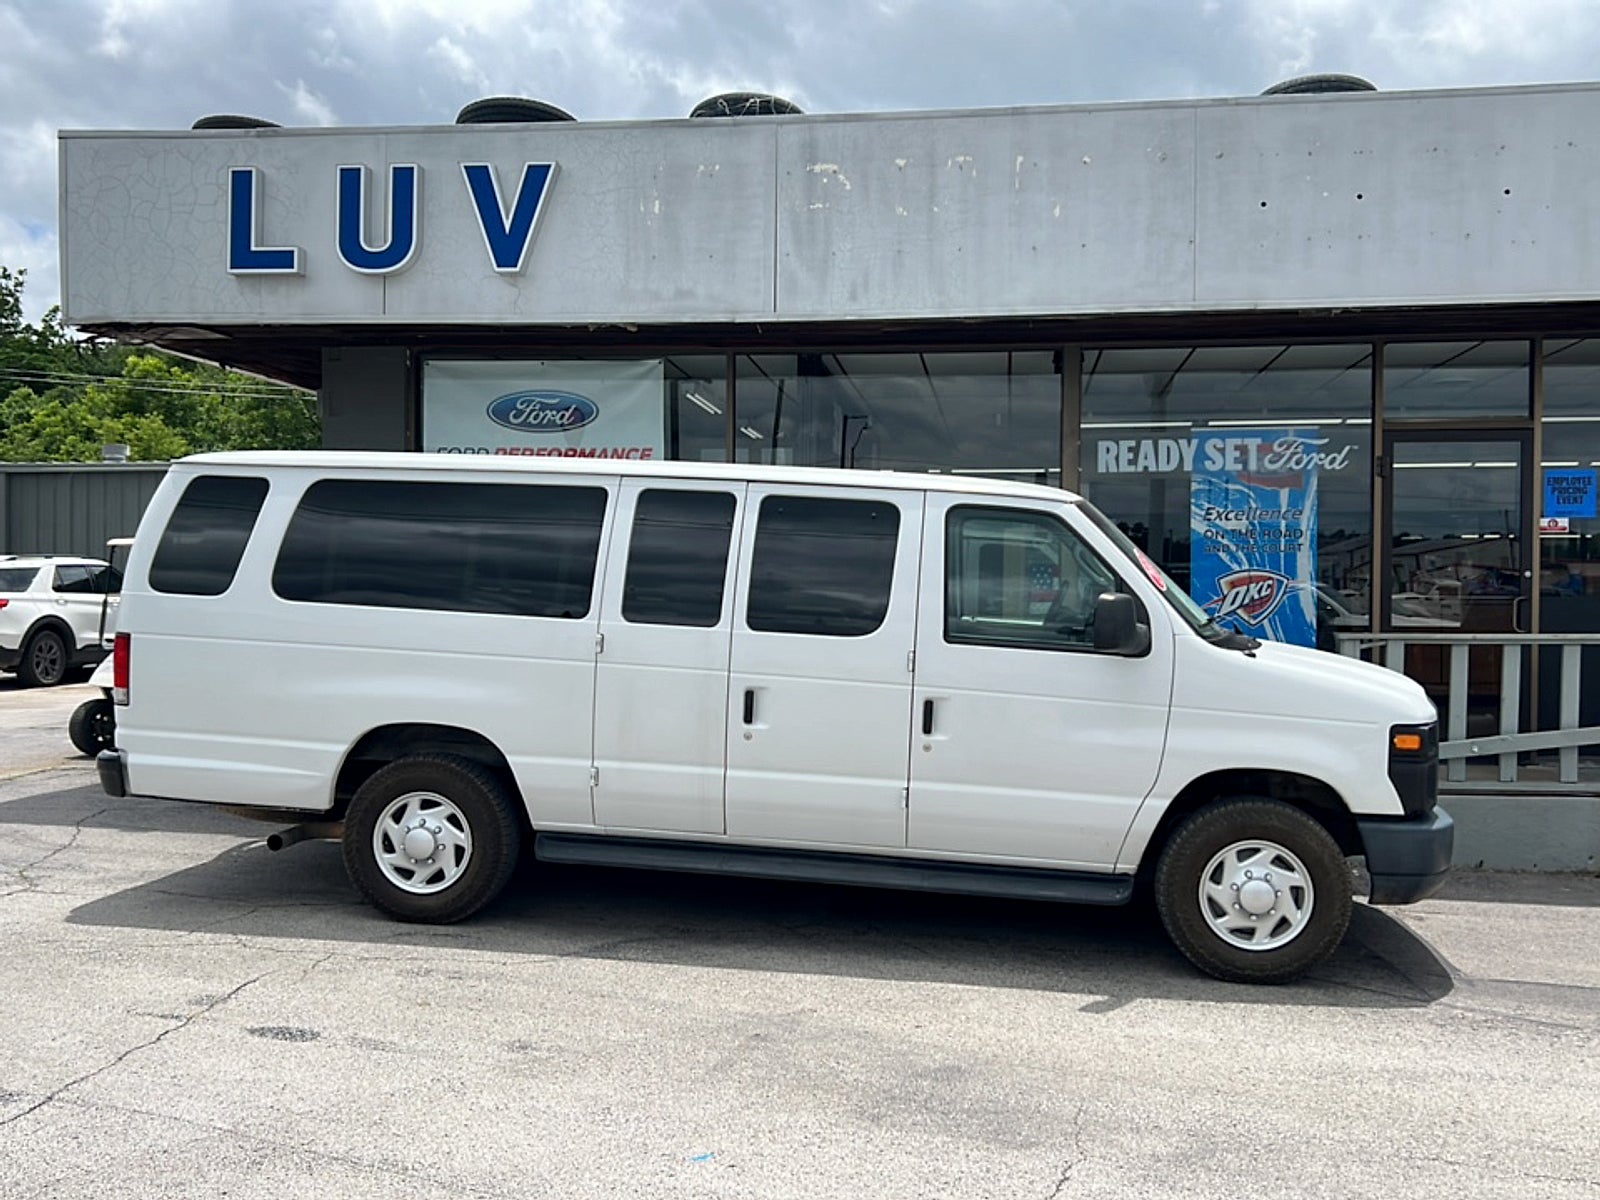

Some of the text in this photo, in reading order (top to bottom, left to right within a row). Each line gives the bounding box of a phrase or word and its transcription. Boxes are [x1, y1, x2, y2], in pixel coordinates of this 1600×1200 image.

[227, 161, 556, 273] LUV
[509, 396, 576, 426] Ford
[1097, 436, 1351, 473] READY SET Ford
[1546, 476, 1593, 487] EMPLOYEE
[1551, 486, 1588, 495] PRICING
[1556, 495, 1583, 505] EVENT
[1203, 506, 1303, 521] Excellence
[1203, 528, 1304, 541] ON THE ROAD
[1204, 543, 1304, 554] AND THE COURT
[1219, 580, 1274, 616] OKC
